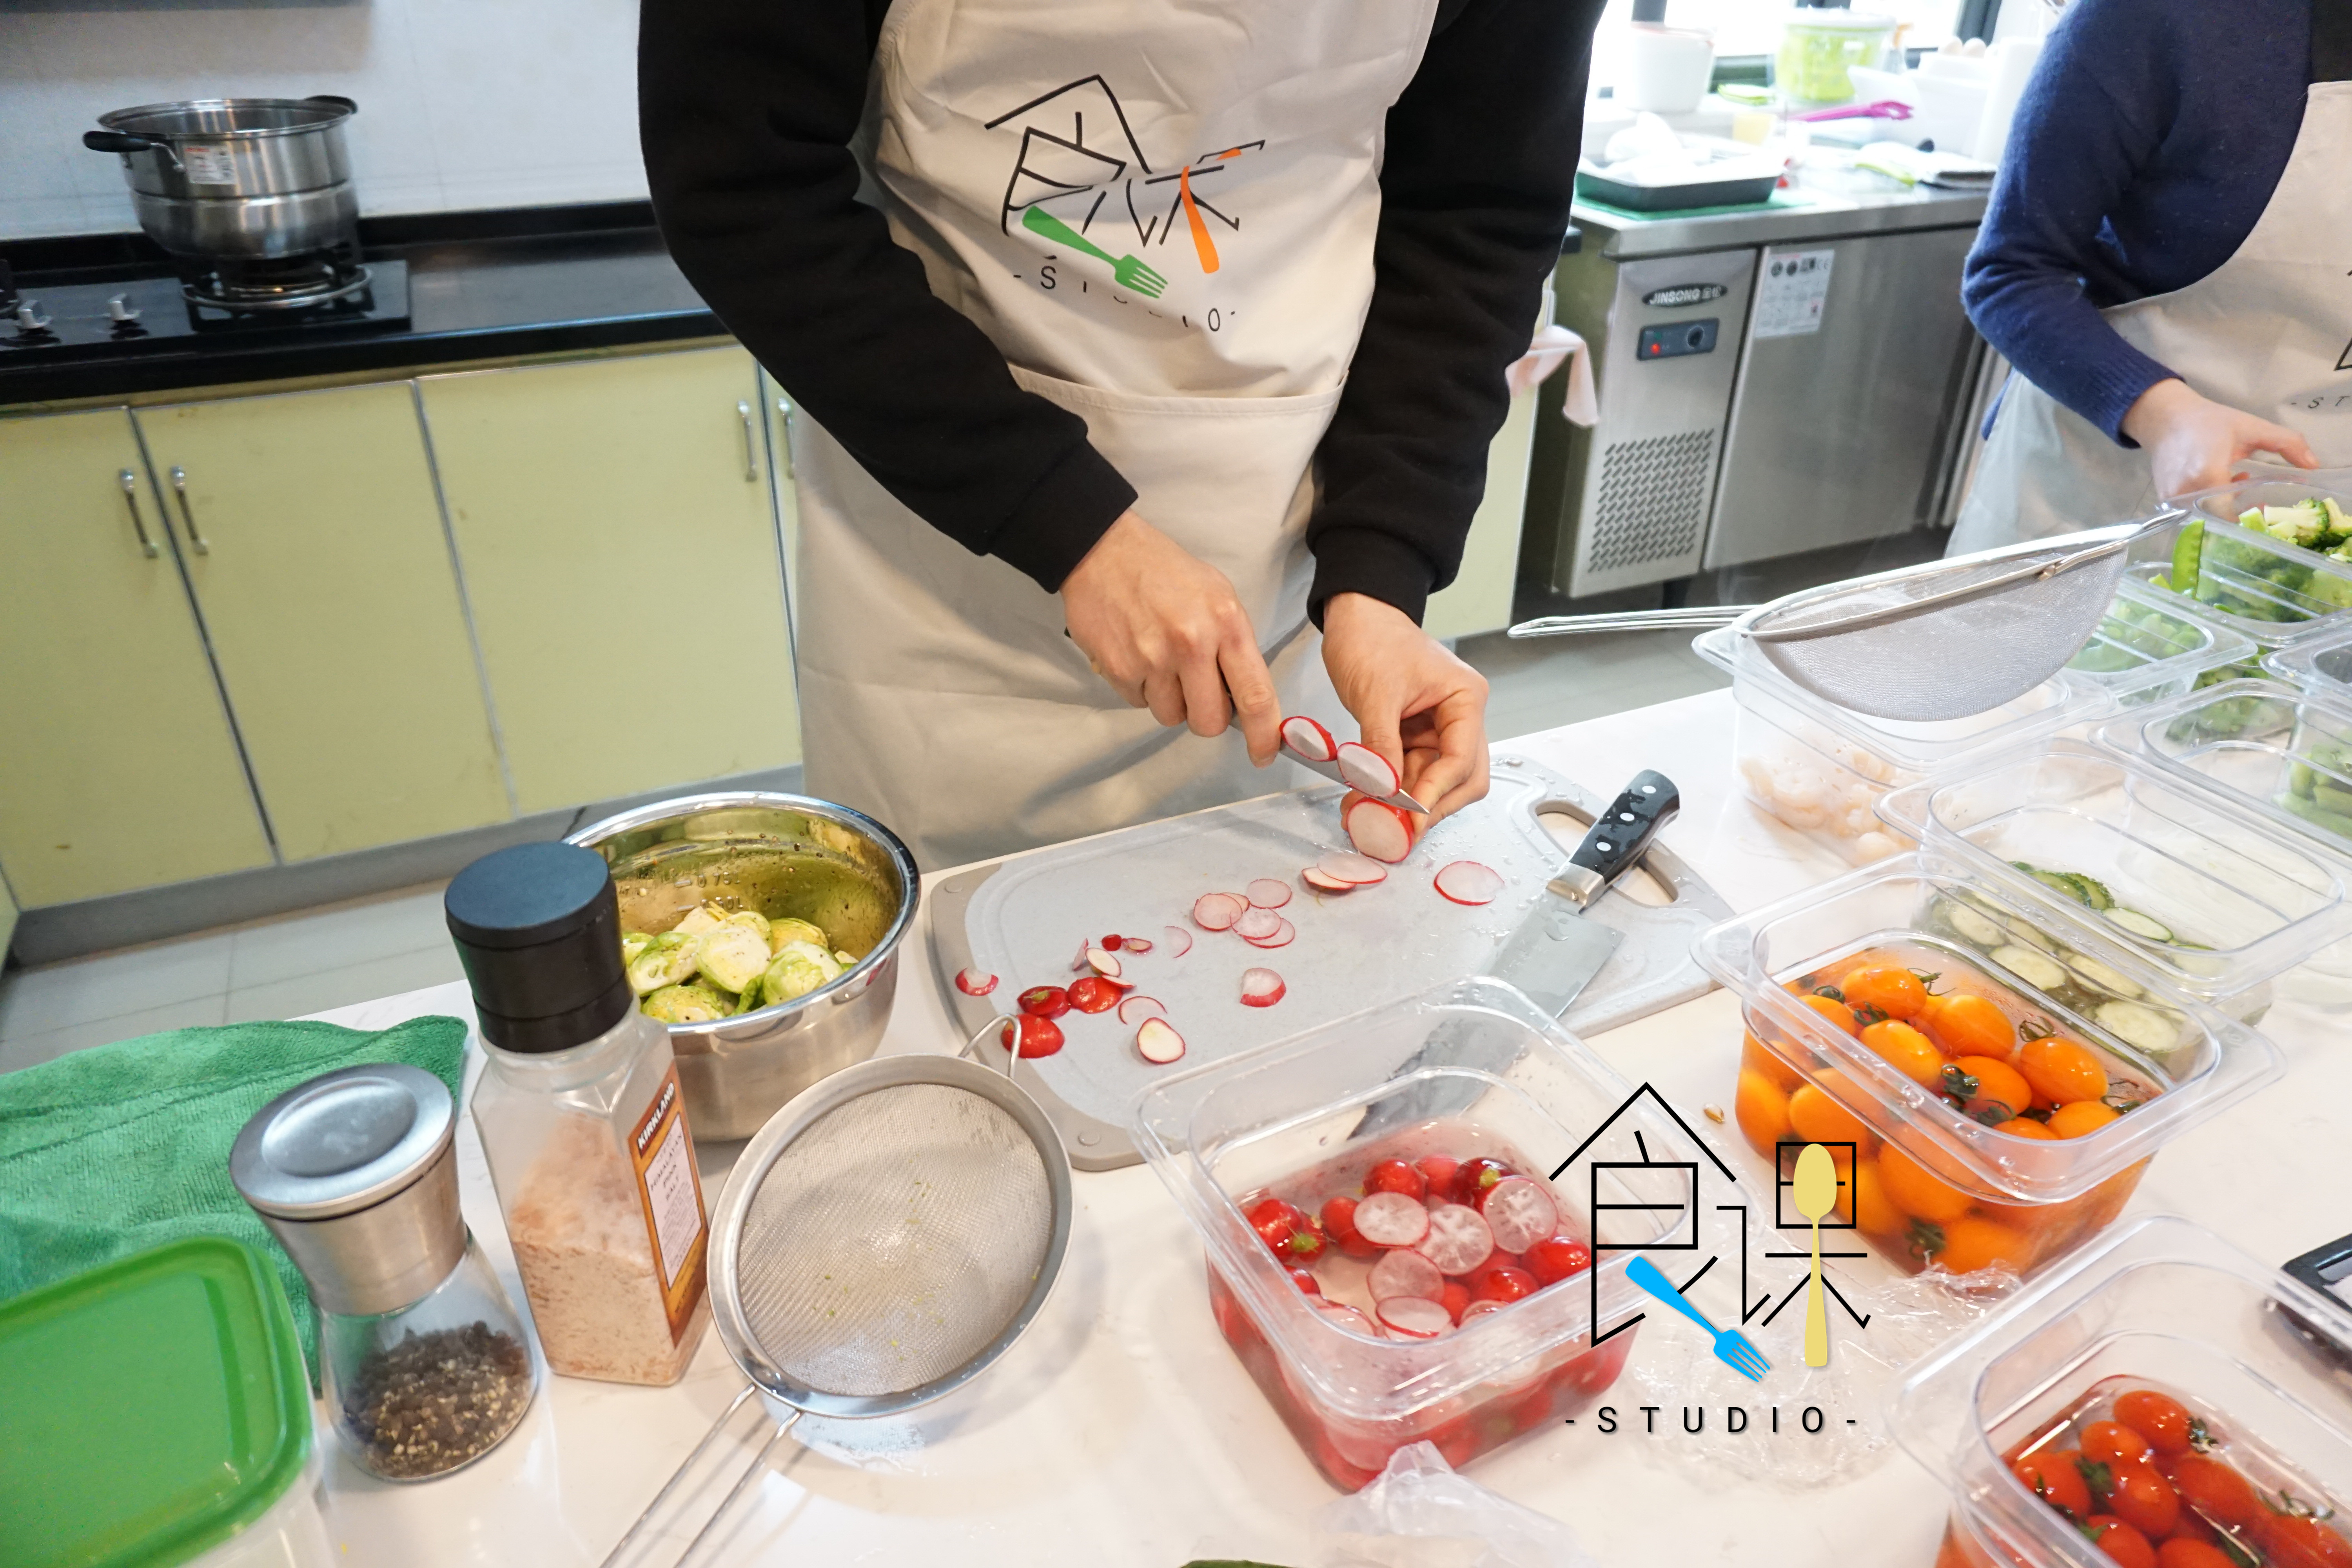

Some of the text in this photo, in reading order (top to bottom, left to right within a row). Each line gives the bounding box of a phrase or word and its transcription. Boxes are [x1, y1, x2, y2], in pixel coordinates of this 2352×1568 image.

[1649, 288, 1700, 305] JINSONG
[697, 871, 742, 888] 075L
[700, 896, 744, 910] 050L
[637, 1082, 674, 1150] KIRKLAND
[650, 1132, 682, 1193] HIMALAYAN
[665, 1174, 679, 1202] SALT
